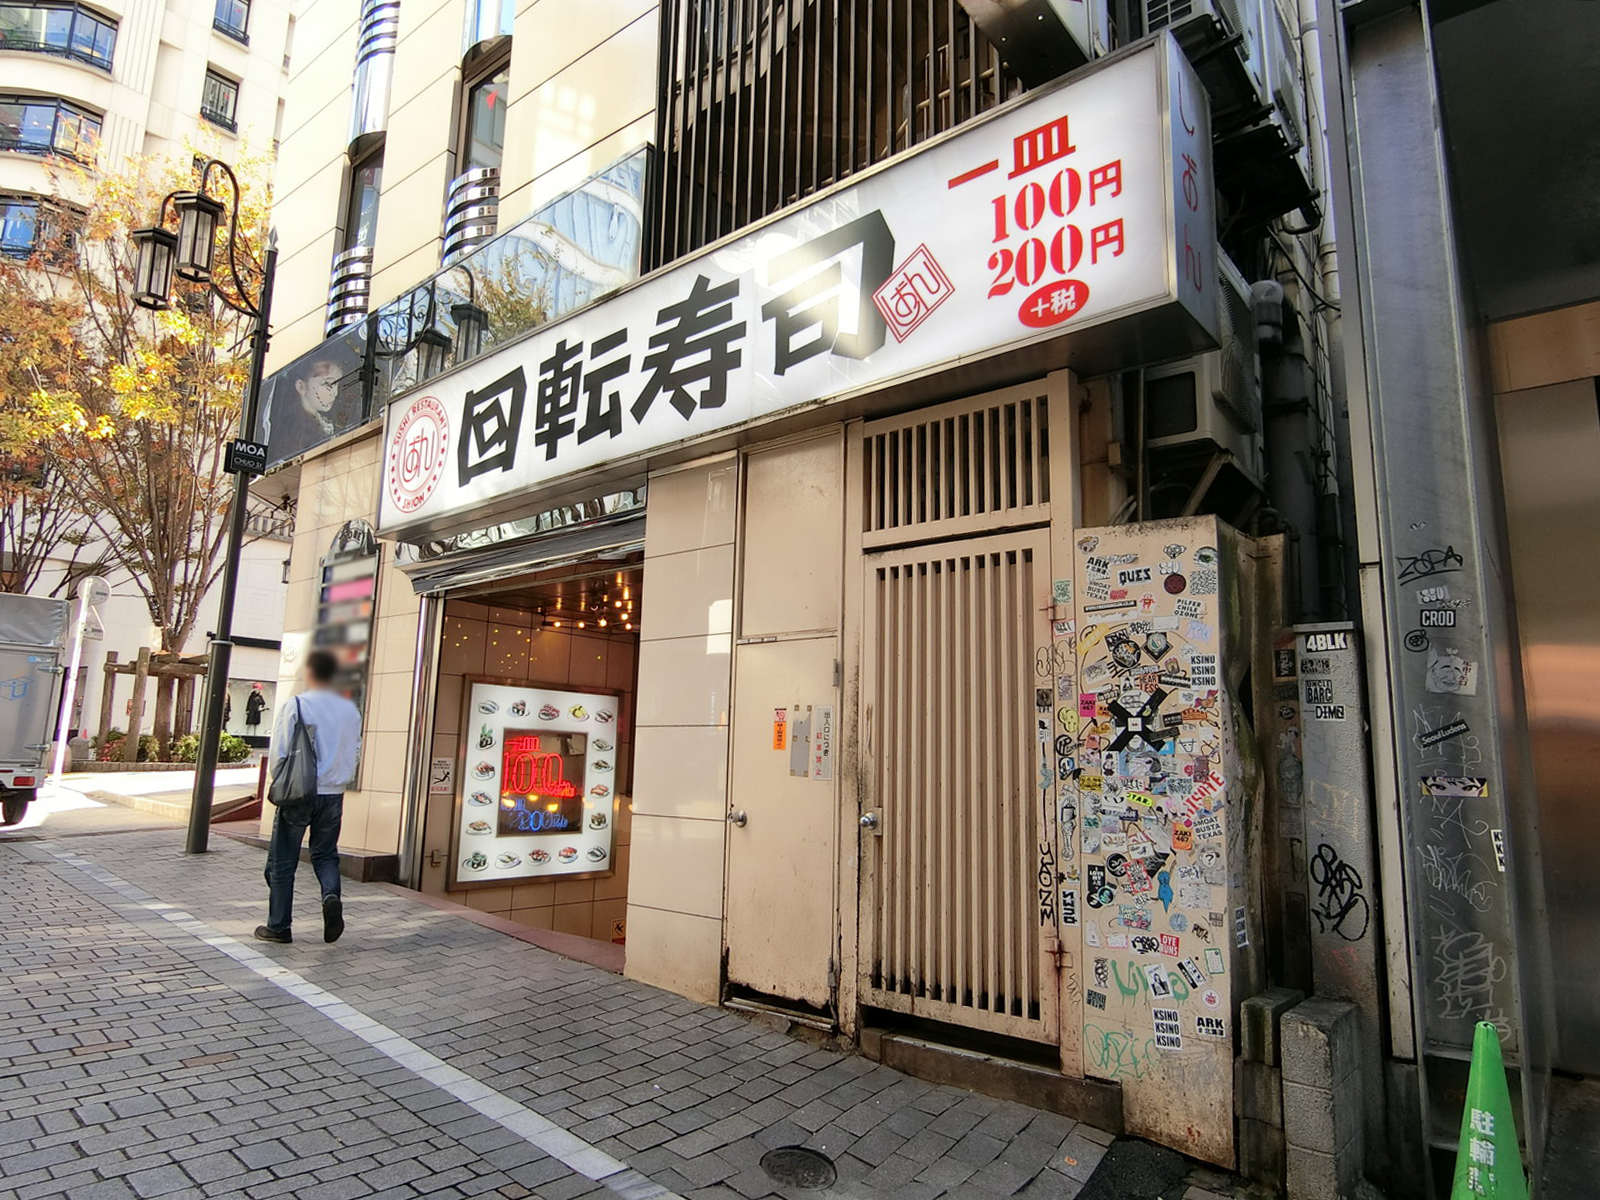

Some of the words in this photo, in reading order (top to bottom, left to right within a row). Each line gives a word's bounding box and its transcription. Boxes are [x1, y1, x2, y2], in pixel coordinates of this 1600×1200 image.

[948, 114, 1076, 190] 一皿
[991, 159, 1122, 244] 100円
[987, 217, 1125, 300] 200円
[458, 209, 896, 487] 回転寿司
[393, 414, 411, 446] SUSHI
[412, 400, 447, 430] RESTAURANT
[235, 441, 266, 457] MOA
[1087, 557, 1110, 569] ARK
[1086, 591, 1107, 601] TEXAS
[1174, 609, 1199, 619] OZONE
[1422, 610, 1455, 627] CROD
[1306, 632, 1347, 651] 4BLK
[1191, 665, 1216, 676] KSINO
[1191, 676, 1217, 686] KSINO
[1193, 816, 1220, 828] SMOAT
[1195, 822, 1221, 834] BUSTA
[1197, 829, 1223, 841] TEXAS
[1153, 1009, 1178, 1022] KSINO
[1155, 1022, 1180, 1035] KSINO
[1197, 1017, 1224, 1029] ARK
[1156, 1034, 1181, 1048] KSINO
